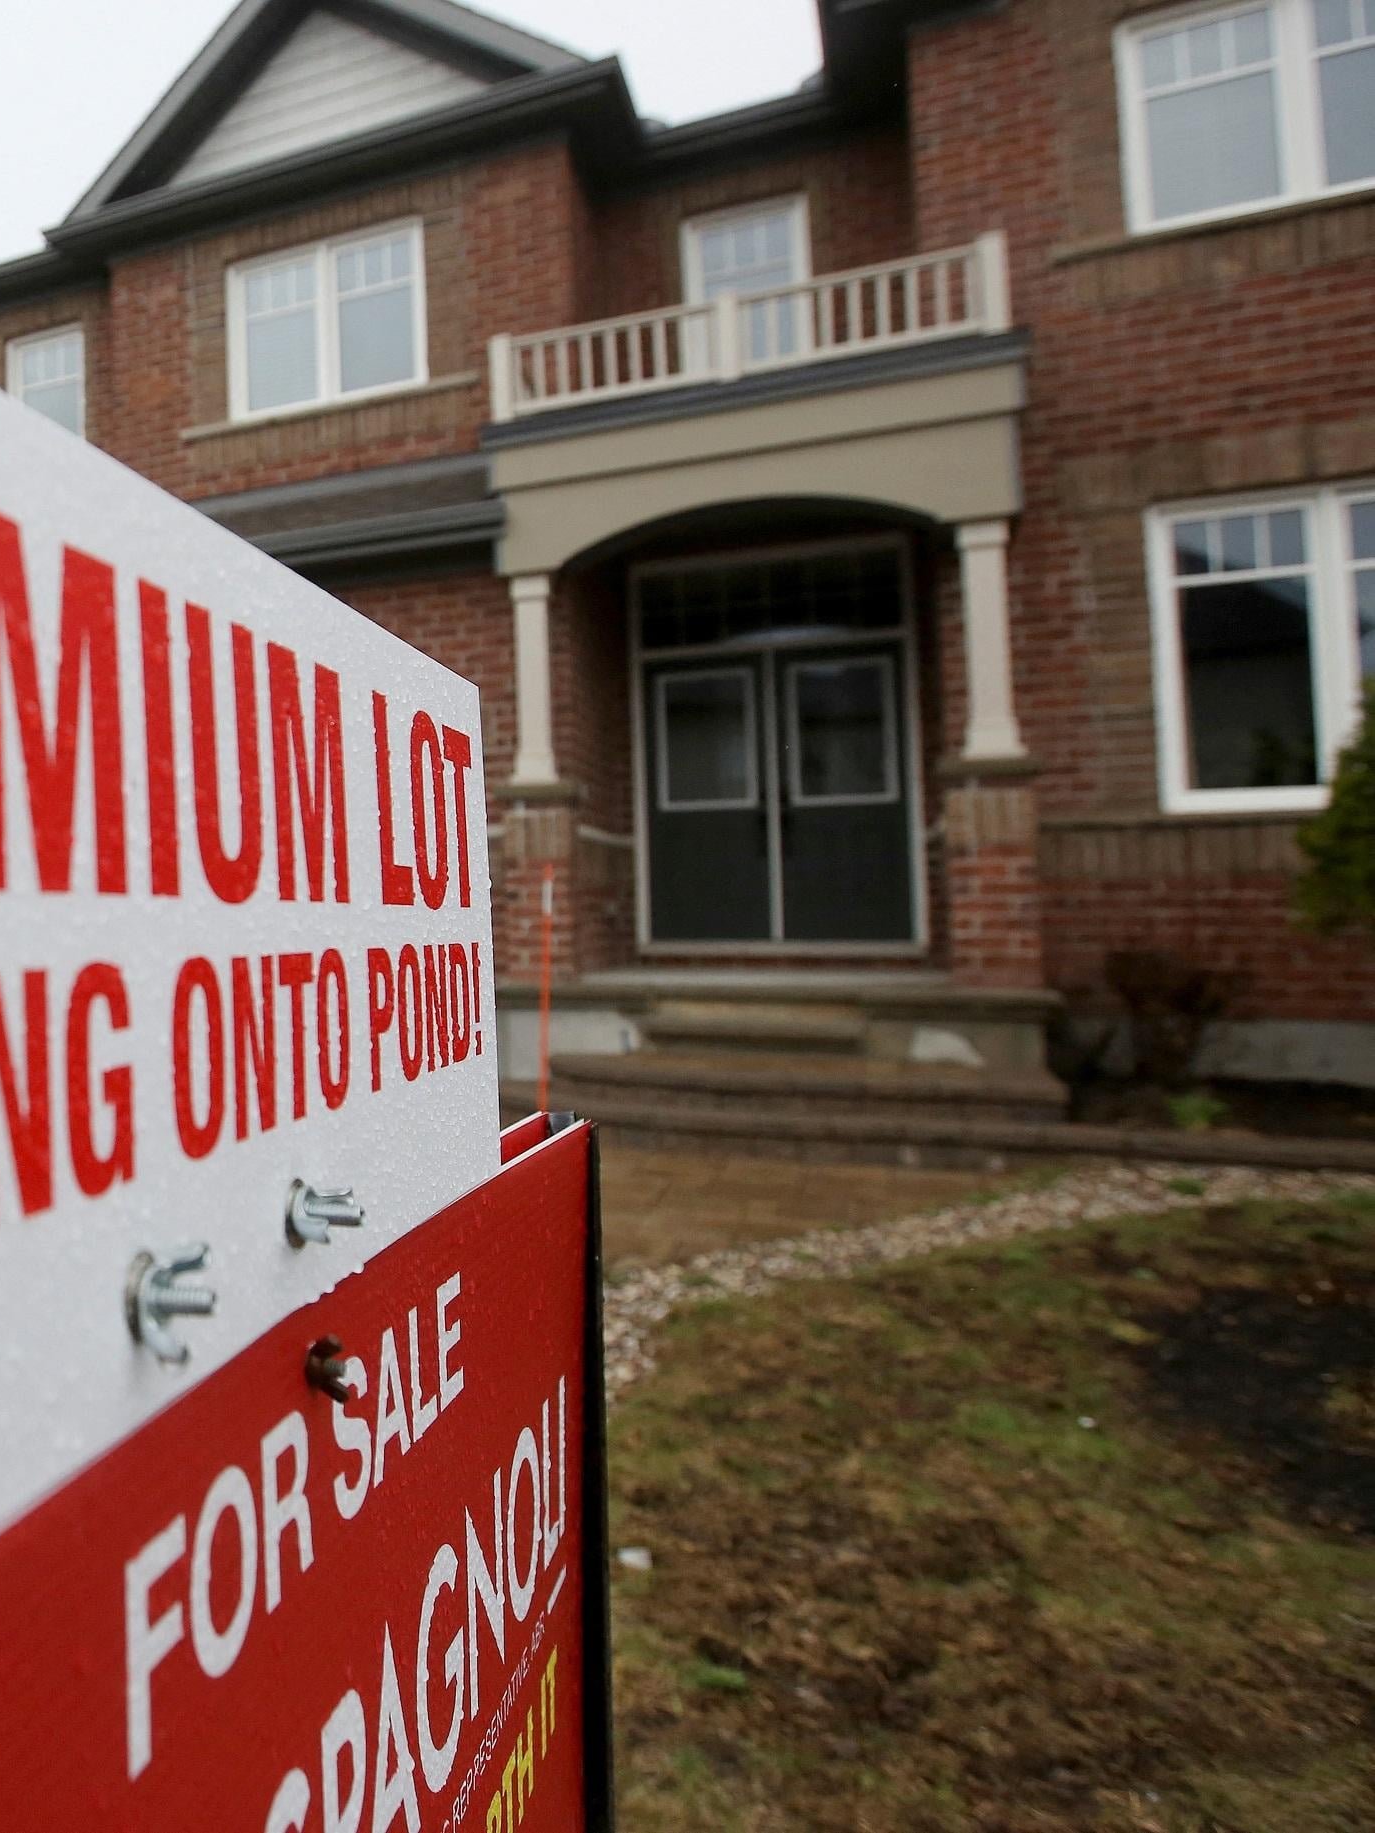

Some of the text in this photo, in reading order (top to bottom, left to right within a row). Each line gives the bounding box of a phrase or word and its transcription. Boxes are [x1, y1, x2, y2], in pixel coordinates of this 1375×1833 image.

[371, 690, 473, 911] LOT
[171, 948, 351, 1161] ONTO
[366, 941, 483, 1093] POND!
[125, 1270, 466, 1782] FOR SALE
[265, 1374, 568, 1833] PAGNOLI
[540, 1643, 558, 1760] IT
